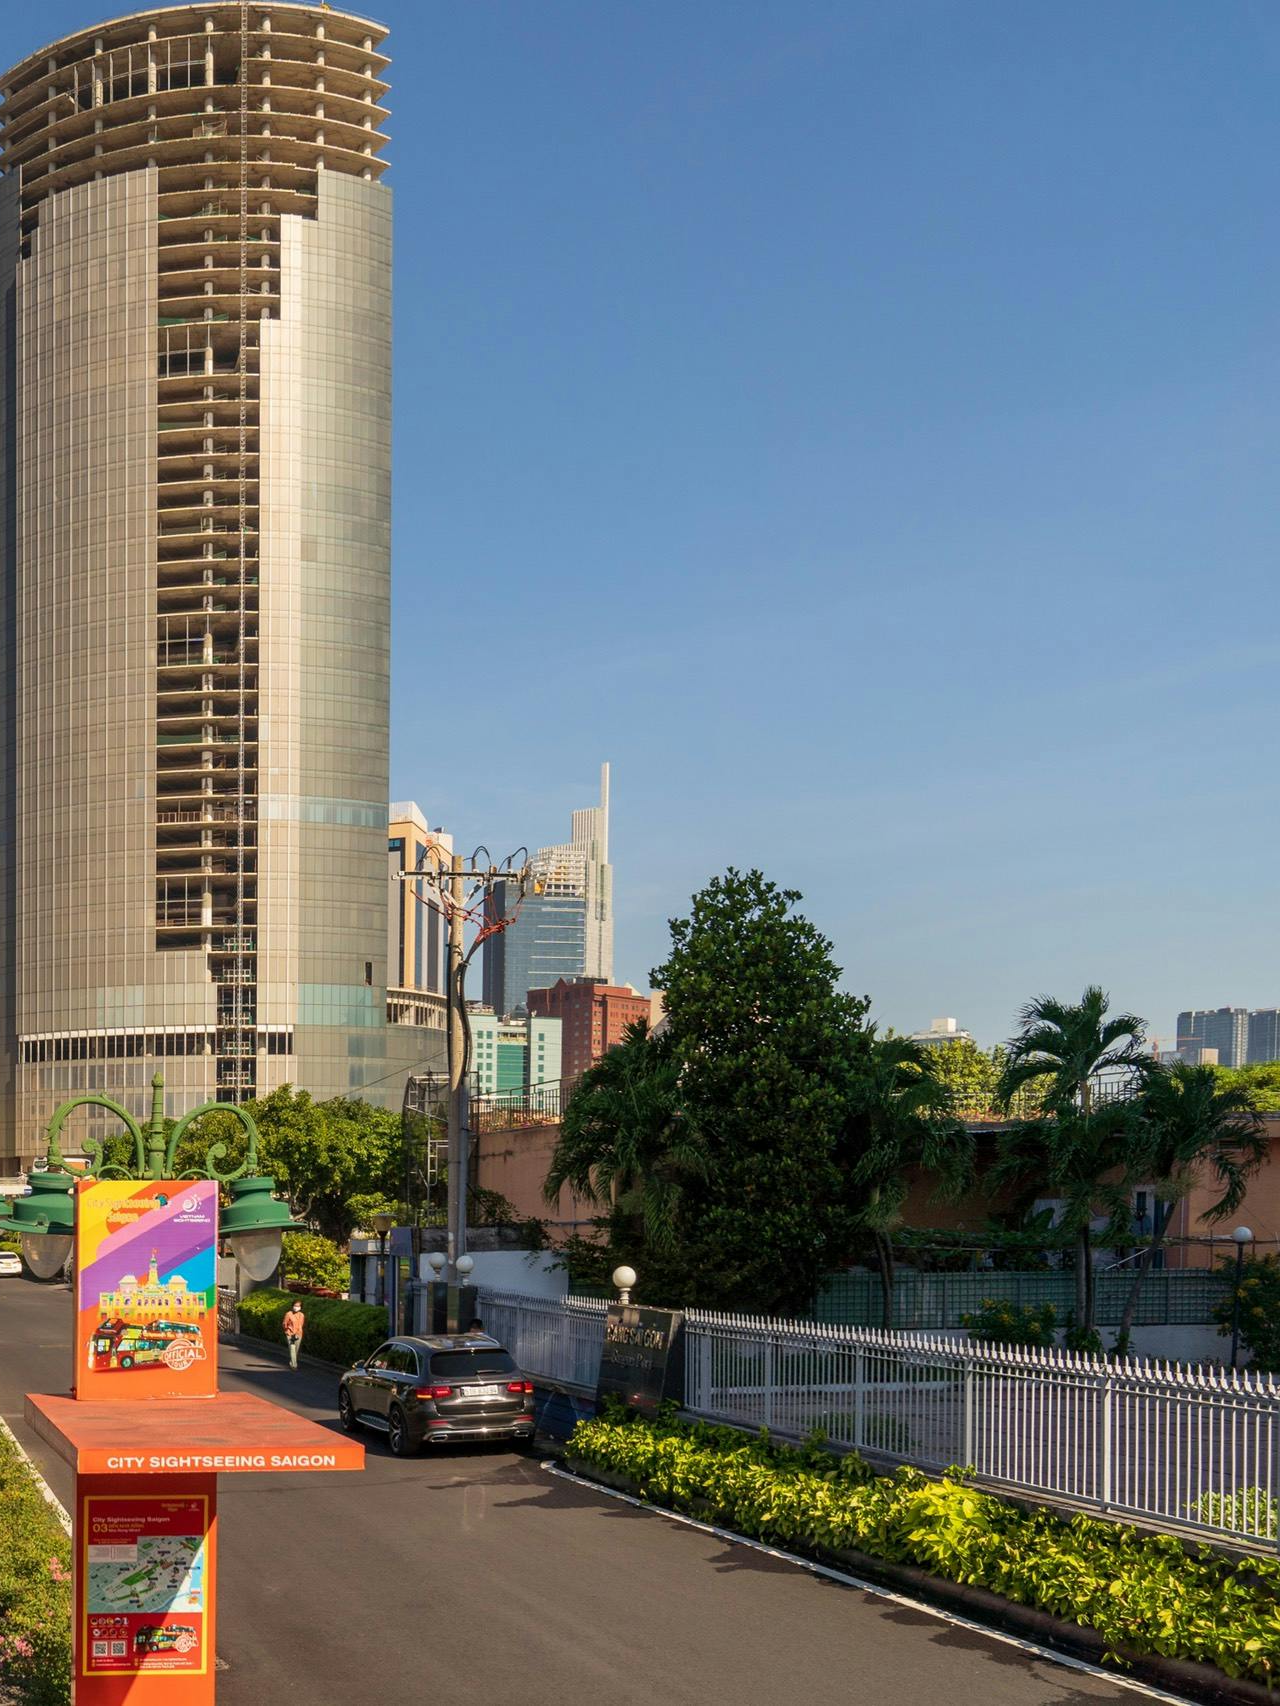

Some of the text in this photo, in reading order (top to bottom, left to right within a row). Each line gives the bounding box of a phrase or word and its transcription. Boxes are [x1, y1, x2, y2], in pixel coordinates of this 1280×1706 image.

[164, 1348, 202, 1360] OFFICIAL
[107, 1455, 336, 1469] CITY SIGHTSEEING SAIGON
[93, 1523, 108, 1532] 03
